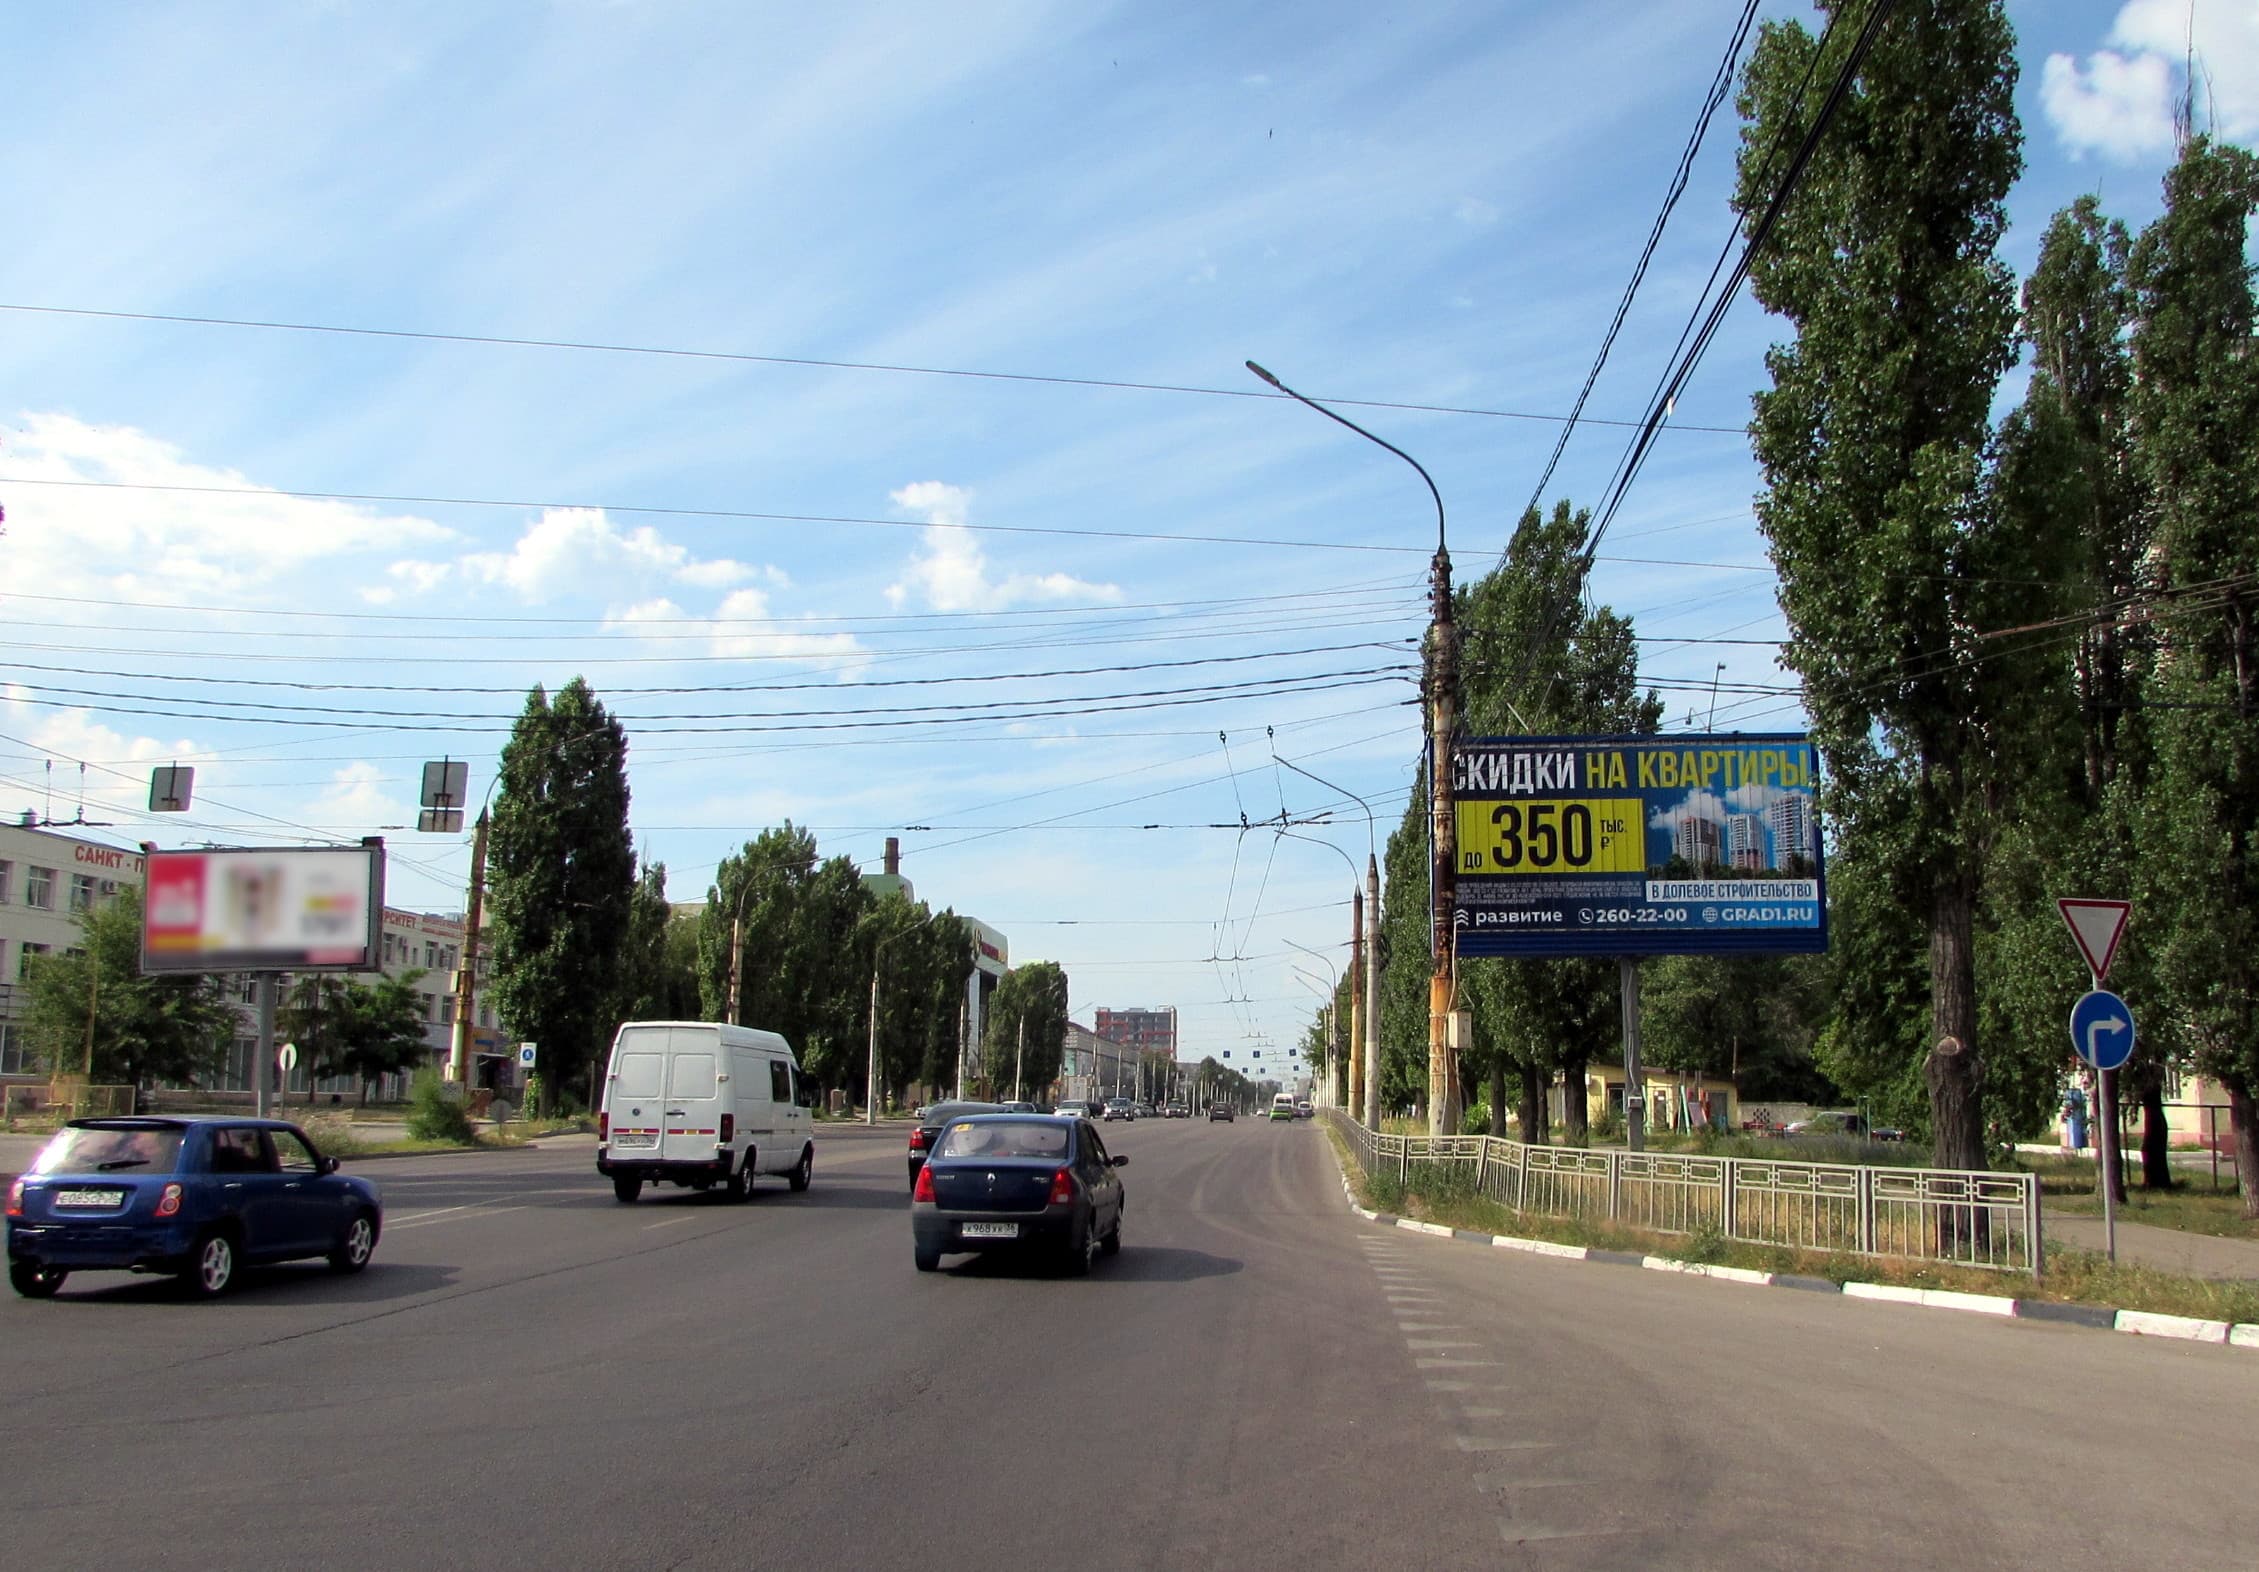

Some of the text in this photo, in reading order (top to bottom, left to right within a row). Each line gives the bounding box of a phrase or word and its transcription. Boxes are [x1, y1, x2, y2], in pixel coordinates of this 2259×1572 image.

[1452, 750, 1809, 795] СКИДКИ НА КВАРТИРЫ
[1464, 852, 1482, 869] ДО
[1491, 804, 1593, 867] 350
[75, 845, 123, 869] САНКТ
[1652, 884, 1660, 898] В
[1662, 883, 1715, 899] ДОЛЕВОЕ
[1718, 883, 1812, 898] СТРОИТЕЛЬСТВО
[1475, 910, 1563, 926] развитие
[1596, 908, 1688, 923] 260-22-00
[1721, 907, 1813, 922] GRAD1.RU
